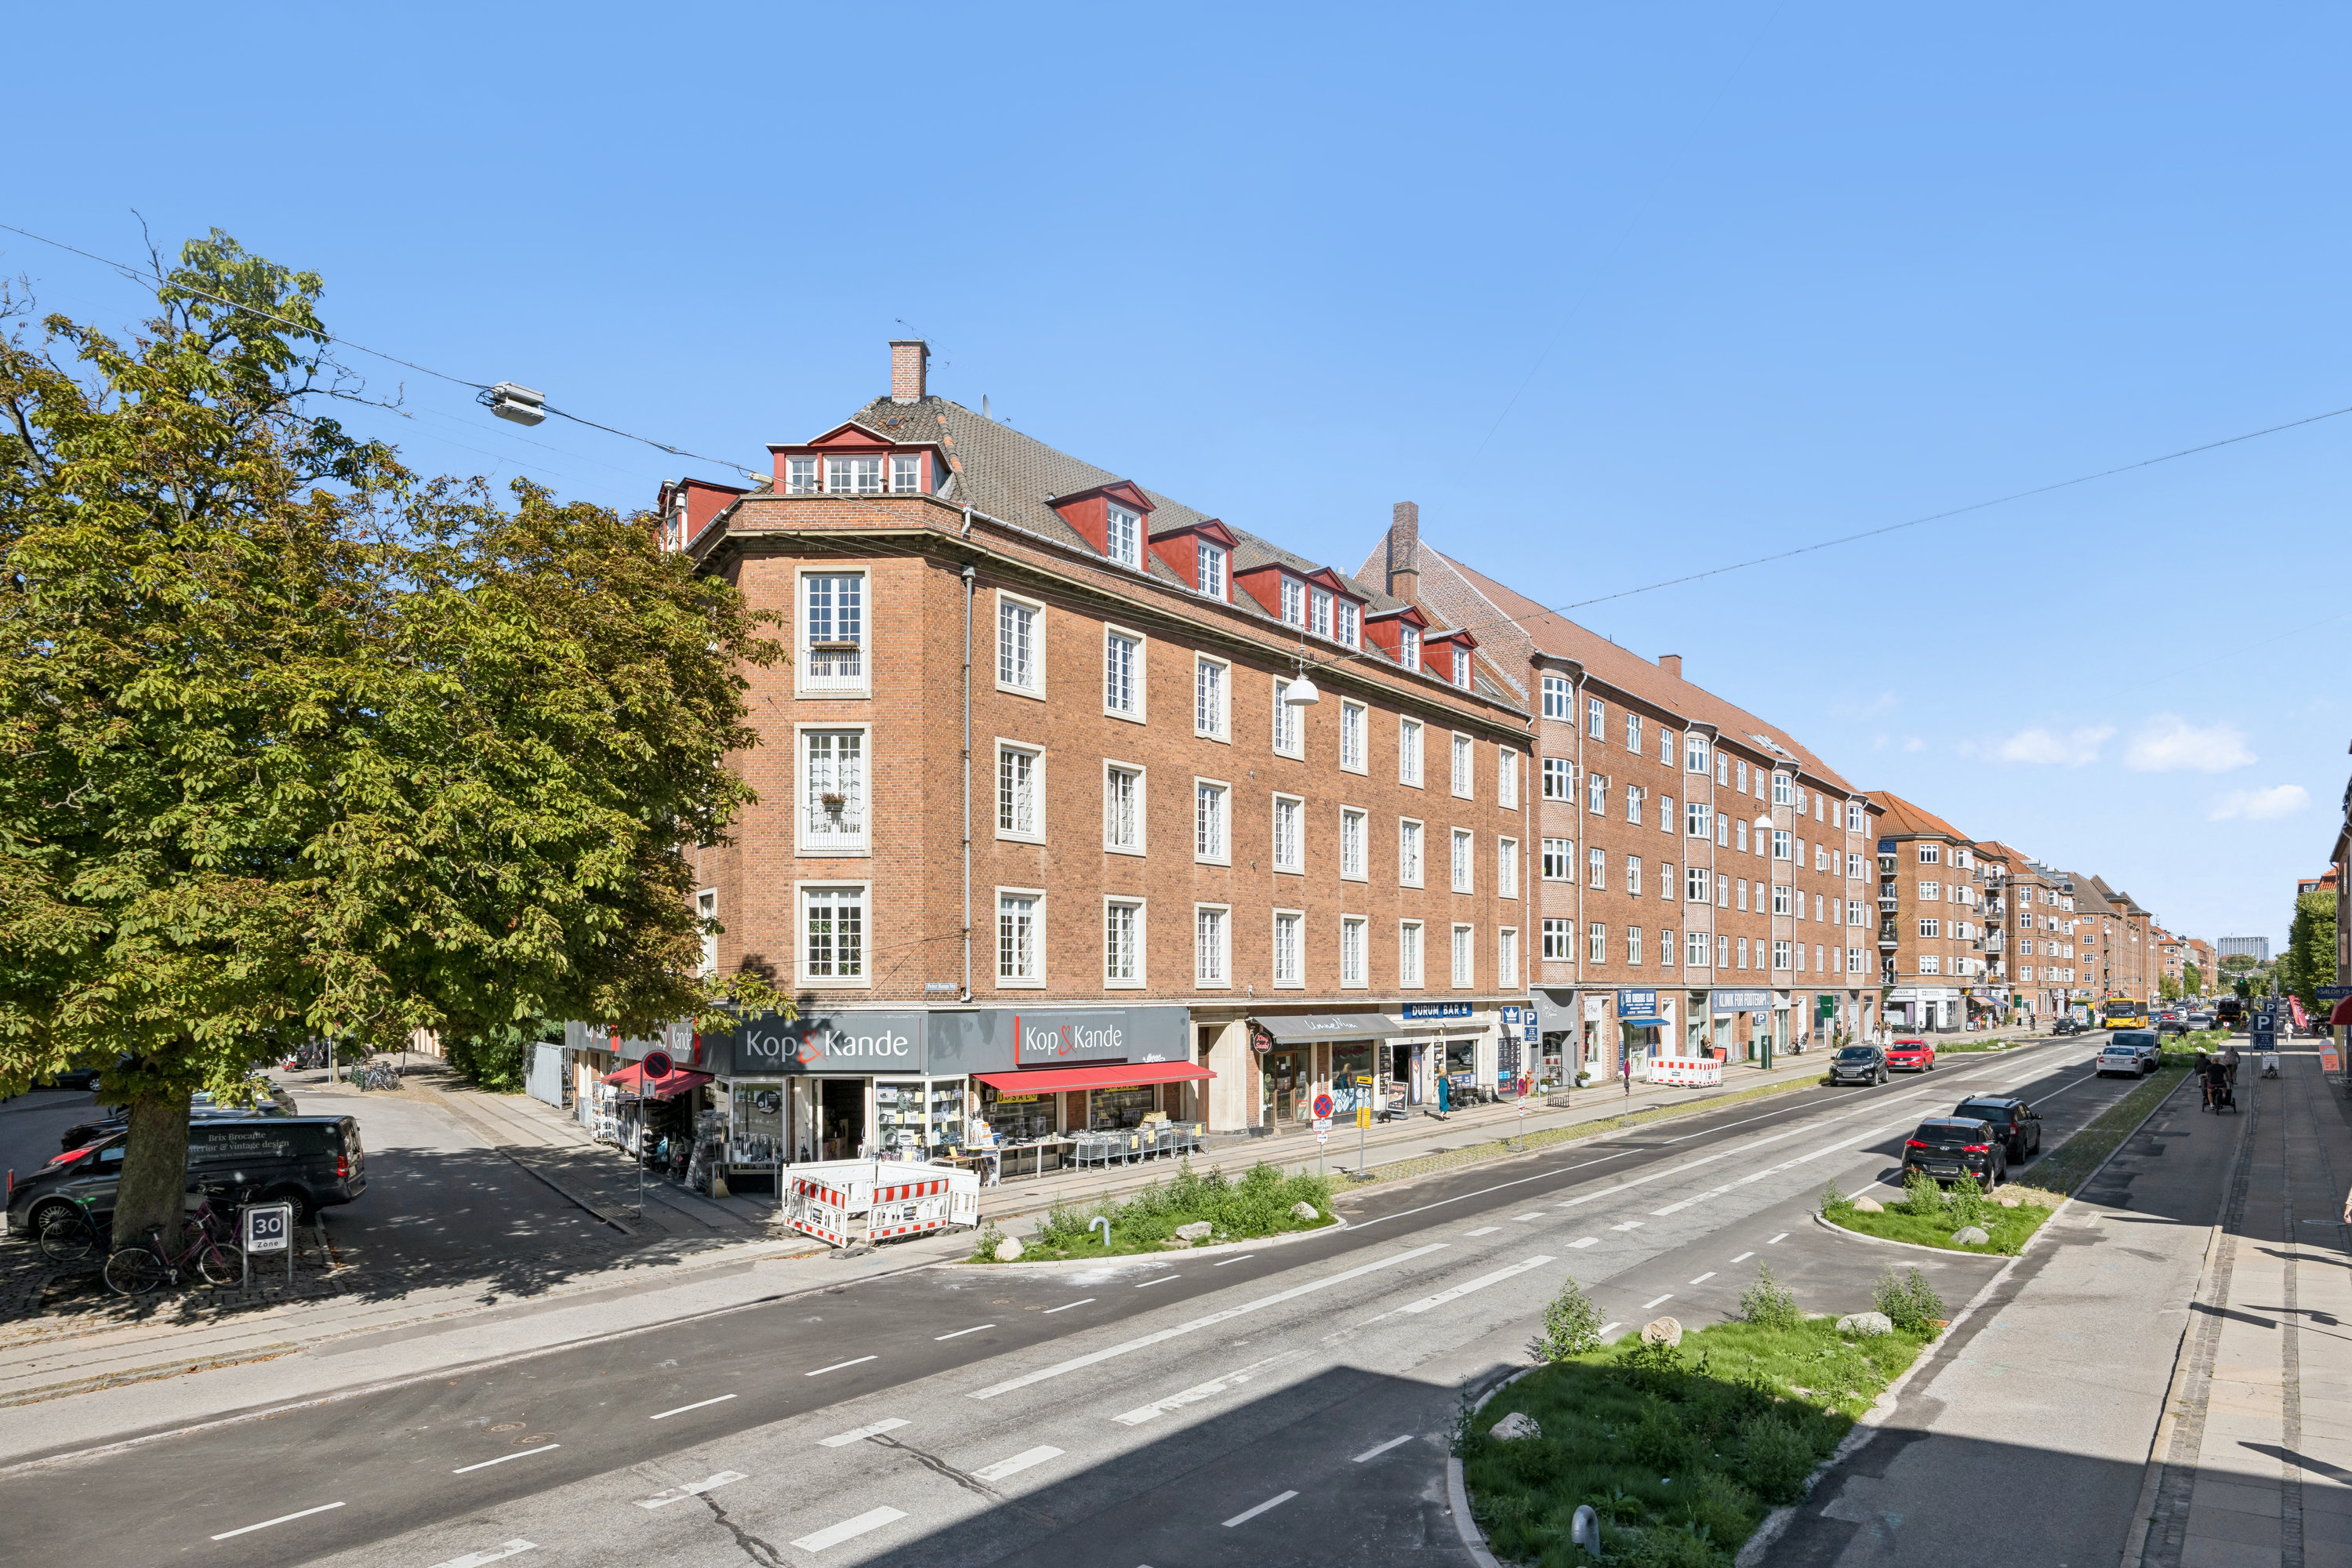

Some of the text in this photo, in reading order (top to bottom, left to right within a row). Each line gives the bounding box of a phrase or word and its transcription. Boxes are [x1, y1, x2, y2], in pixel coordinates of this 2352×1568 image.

[1719, 993, 1734, 1007] KLINIK
[1734, 993, 1744, 1007] FOR
[1412, 1004, 1460, 1017] DURUM BAR
[2267, 1004, 2274, 1013] P
[1526, 1012, 1536, 1025] P
[1758, 1014, 1765, 1023] P
[2258, 1016, 2270, 1029] P
[746, 1030, 797, 1062] Kop
[825, 1029, 909, 1057] Kande
[1025, 1026, 1058, 1055] Kop
[1074, 1024, 1122, 1048] Kande
[209, 1134, 227, 1142] Brix
[188, 1144, 218, 1153] nterior
[229, 1141, 260, 1150] vintage
[262, 1139, 290, 1149] design
[255, 1217, 281, 1234] 30
